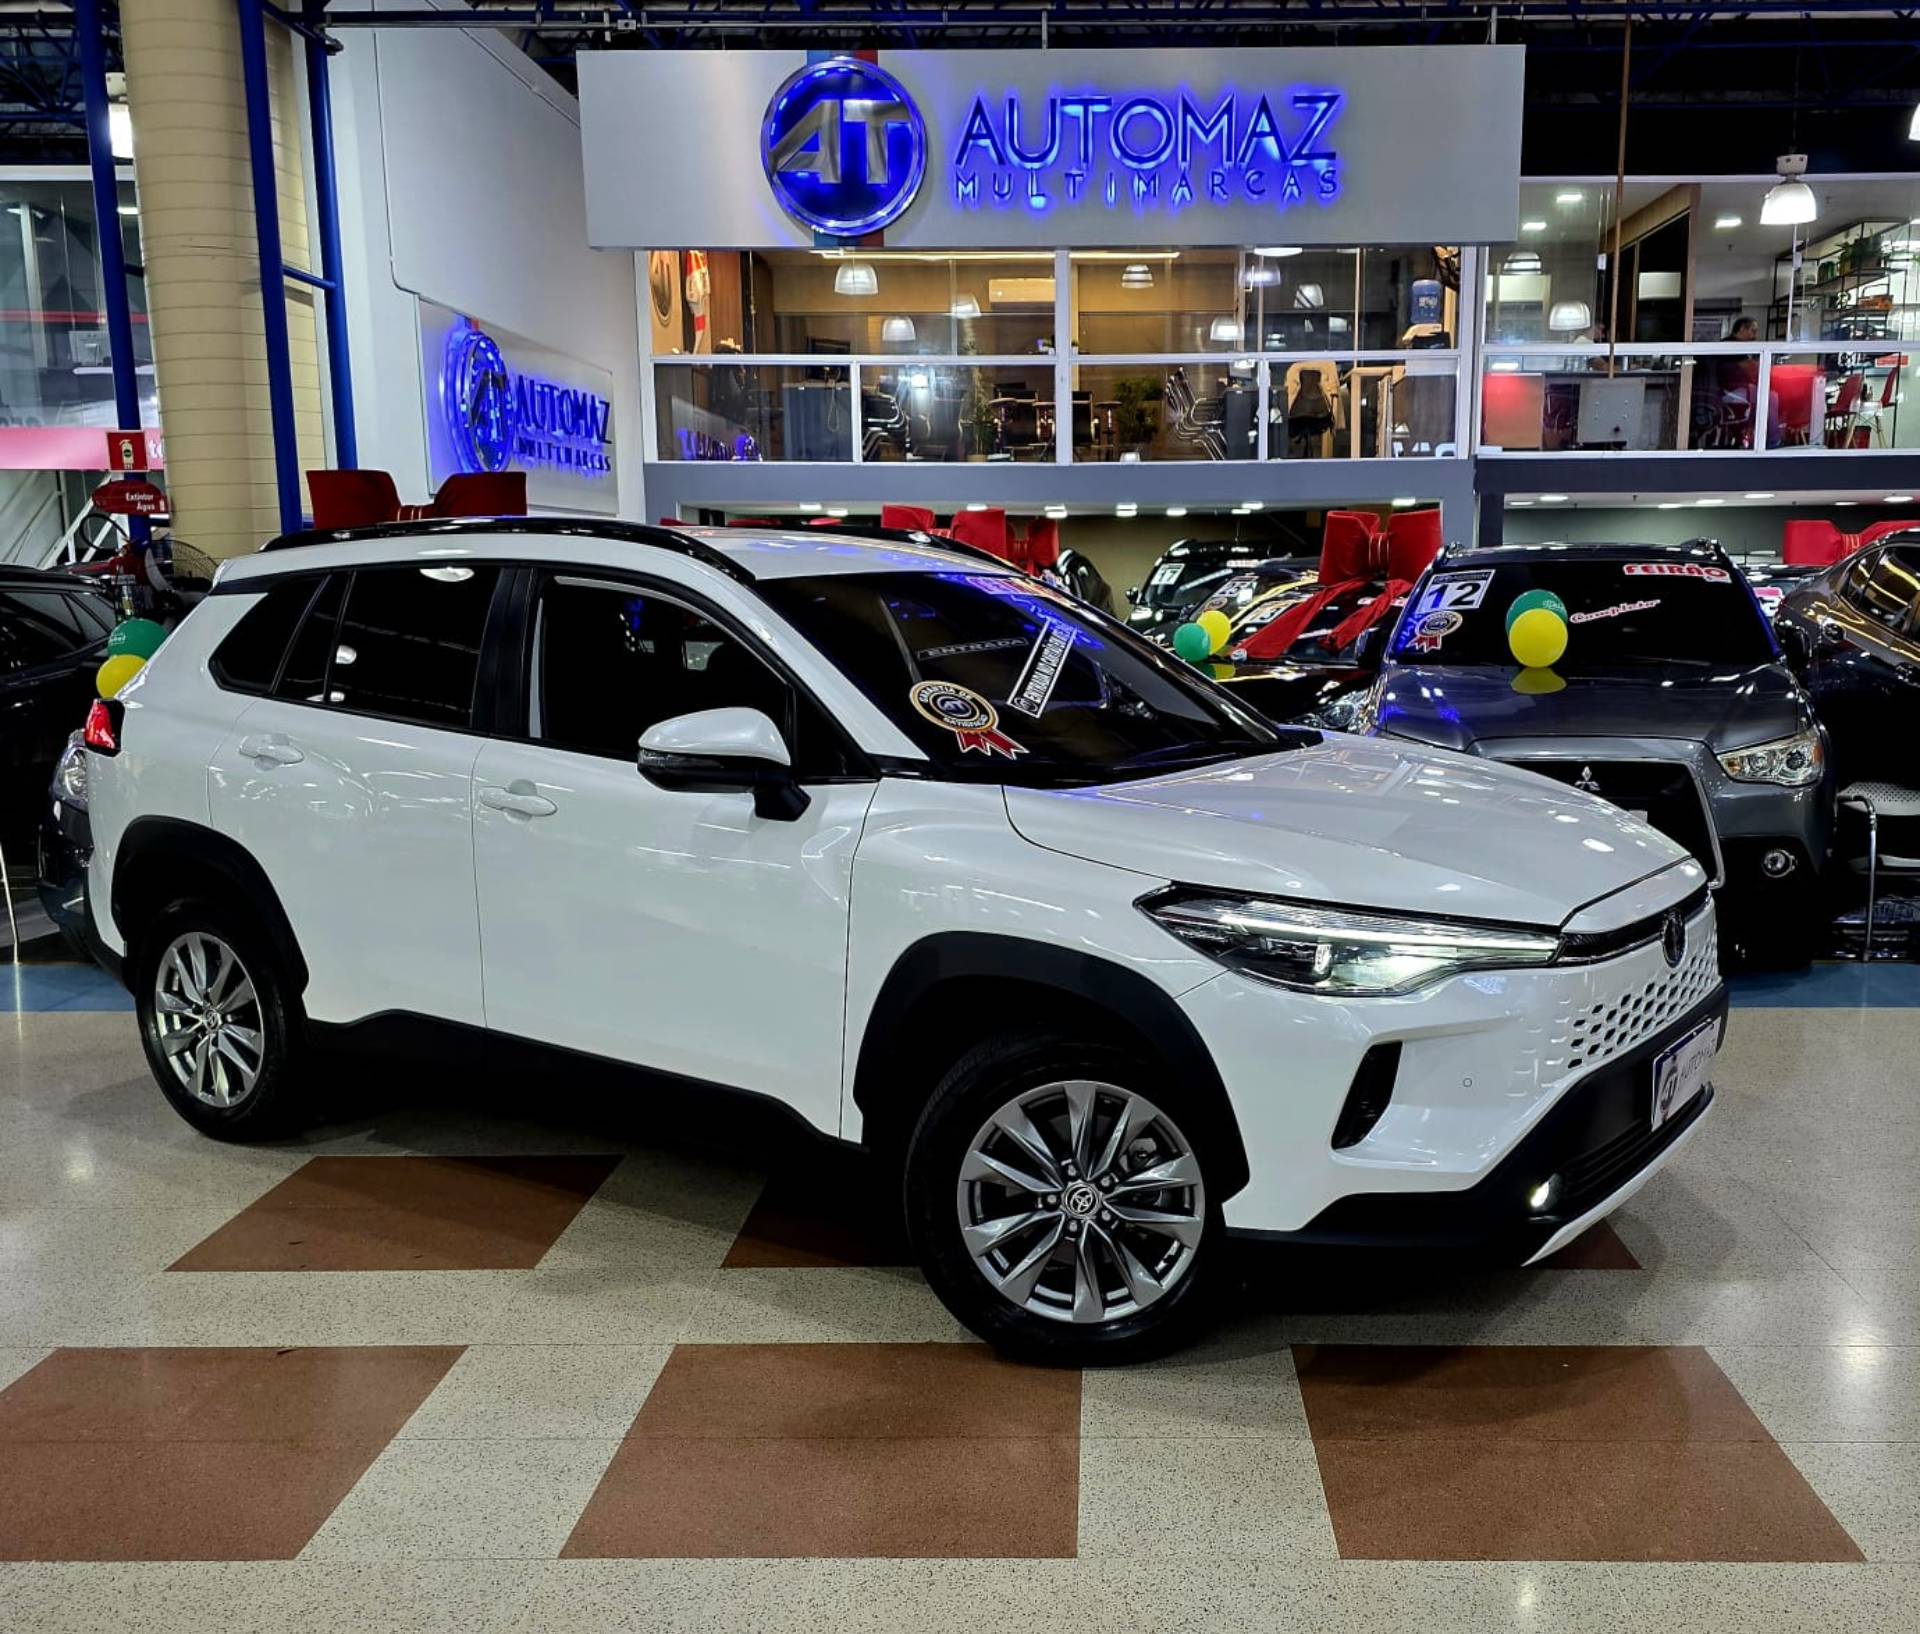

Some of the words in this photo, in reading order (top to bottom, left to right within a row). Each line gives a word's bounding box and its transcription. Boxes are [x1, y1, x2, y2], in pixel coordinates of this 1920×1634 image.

[954, 93, 1342, 170] AUTOMAZ
[955, 172, 1338, 202] MULTIMARCAS
[515, 374, 612, 445] AUTOMAZ
[1427, 582, 1482, 609] 12
